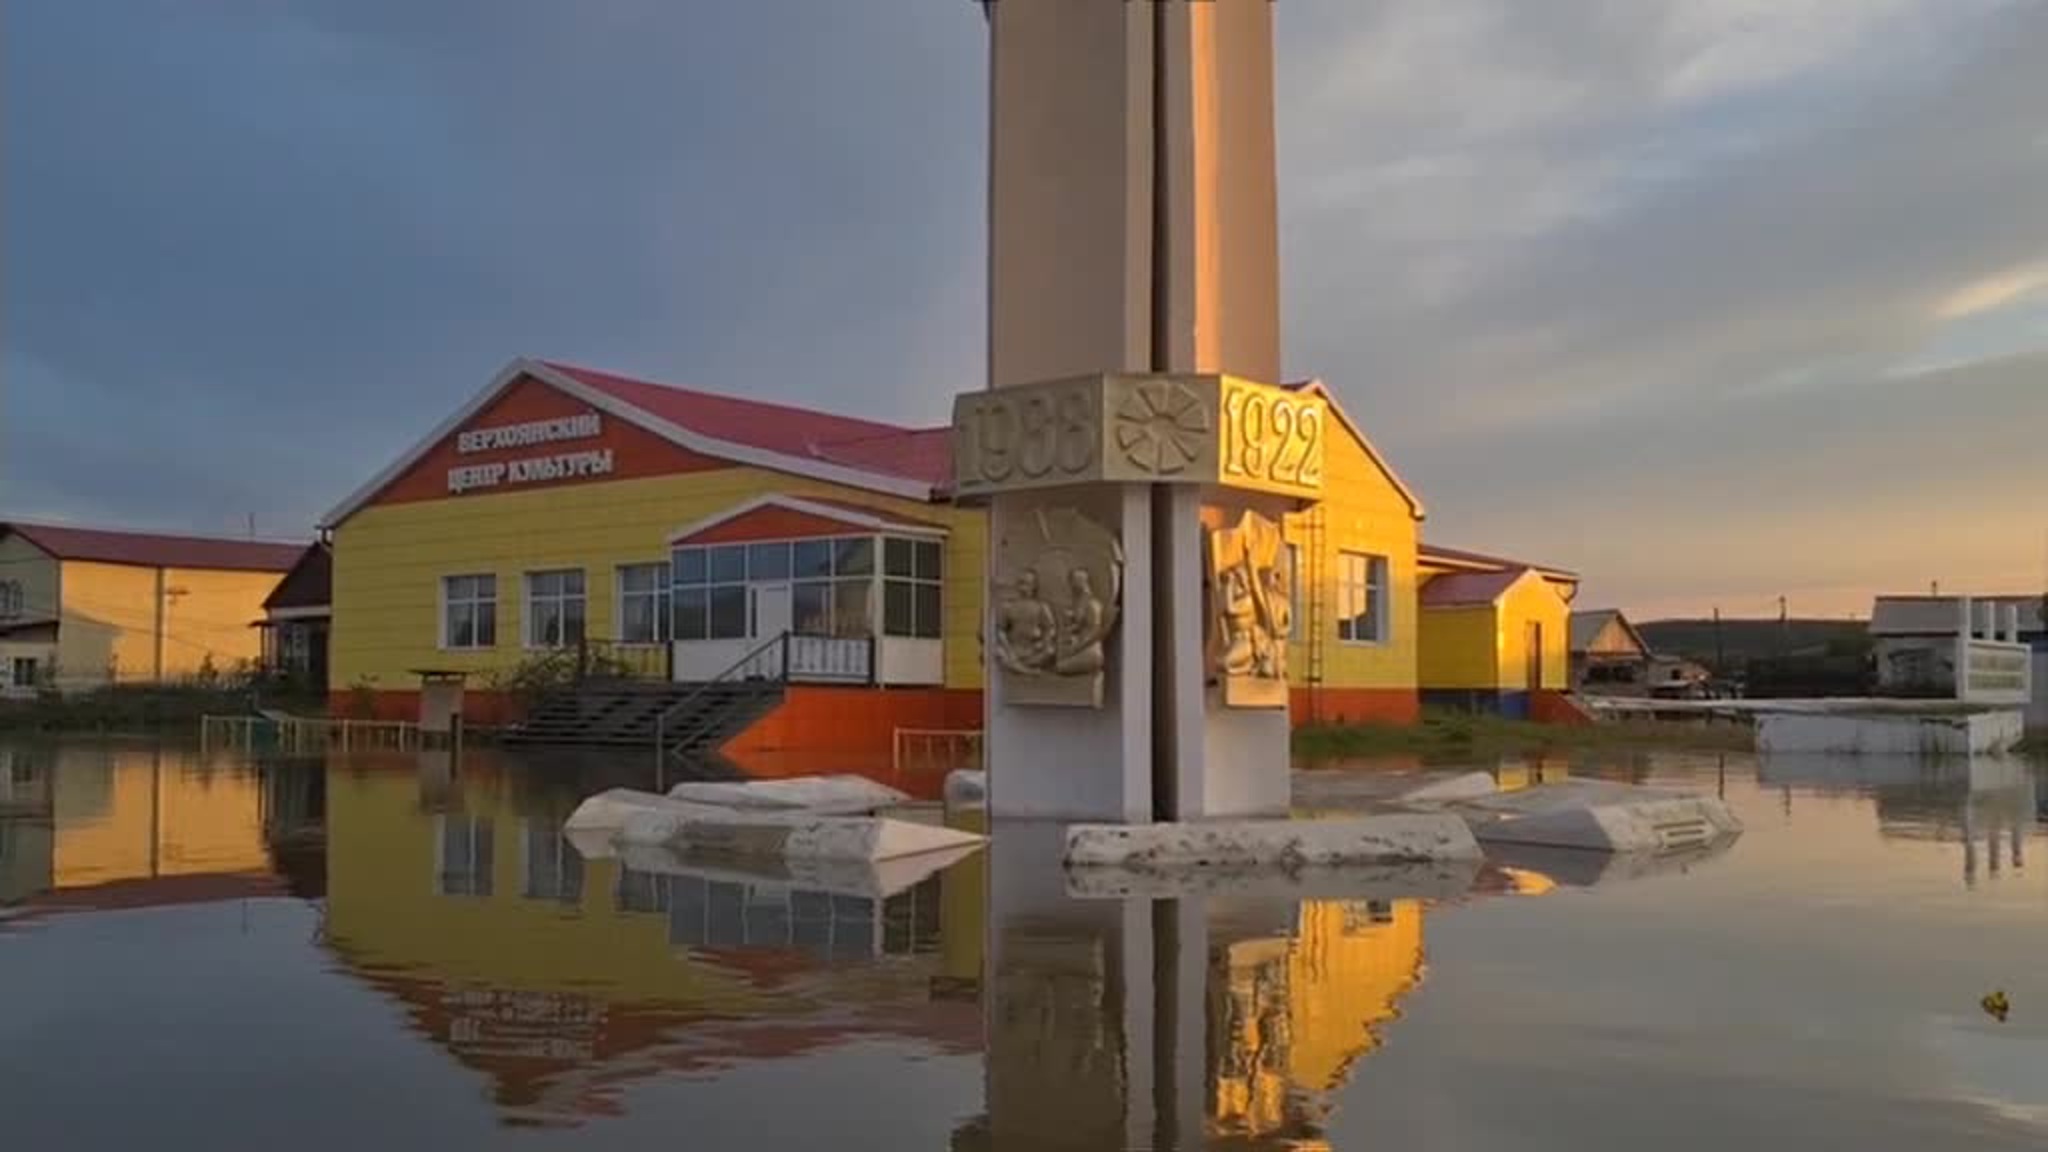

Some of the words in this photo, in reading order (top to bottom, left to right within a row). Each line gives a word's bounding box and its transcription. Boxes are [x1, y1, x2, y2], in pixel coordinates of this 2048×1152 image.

[458, 410, 600, 452] ВЕРХОЯНСКИЙ
[1224, 387, 1322, 488] 1922
[448, 464, 504, 493] ЦЕНТР
[509, 450, 612, 482] КУЛЬТУРЫ
